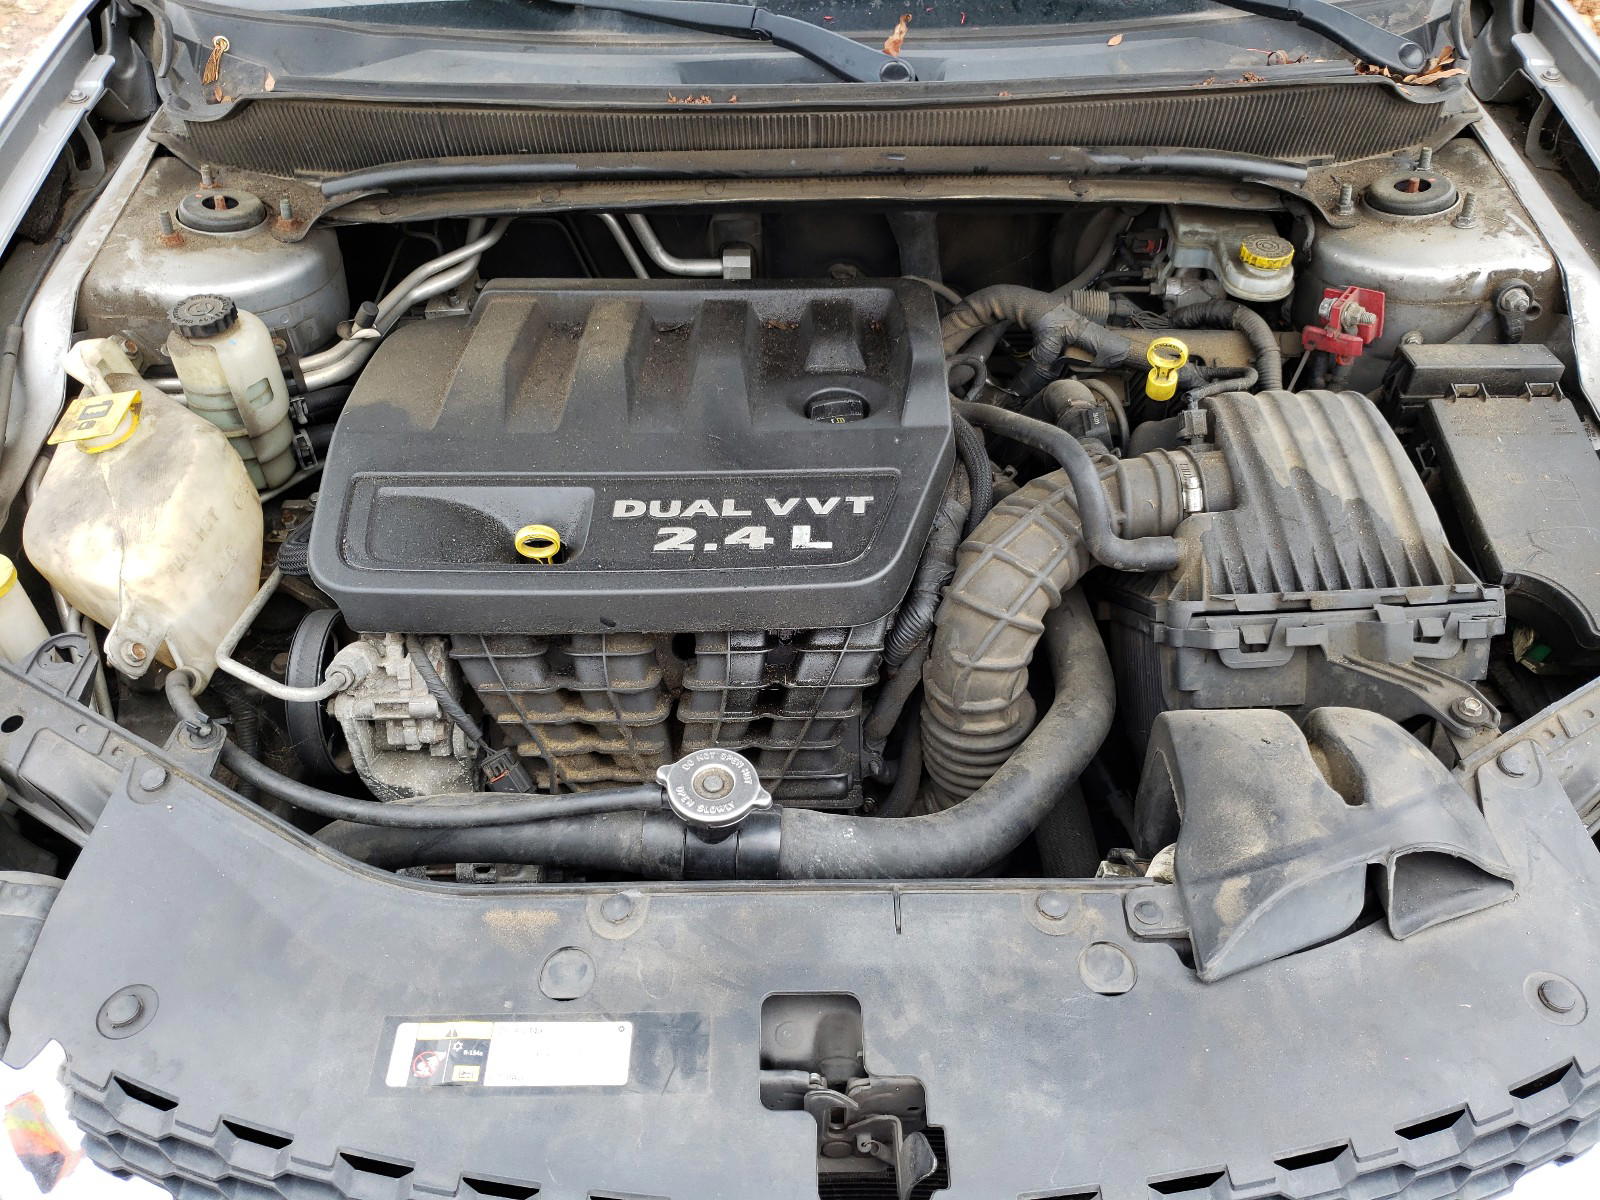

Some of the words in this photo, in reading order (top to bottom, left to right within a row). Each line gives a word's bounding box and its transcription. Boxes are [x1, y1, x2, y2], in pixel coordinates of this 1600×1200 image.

[612, 499, 752, 518] DUAL
[764, 496, 875, 516] VVT
[653, 525, 775, 552] 2.4
[791, 525, 833, 550] L
[682, 760, 694, 770] DO
[697, 752, 716, 760] NOT
[676, 786, 695, 807] OPEN
[697, 801, 735, 814] SLOWLY
